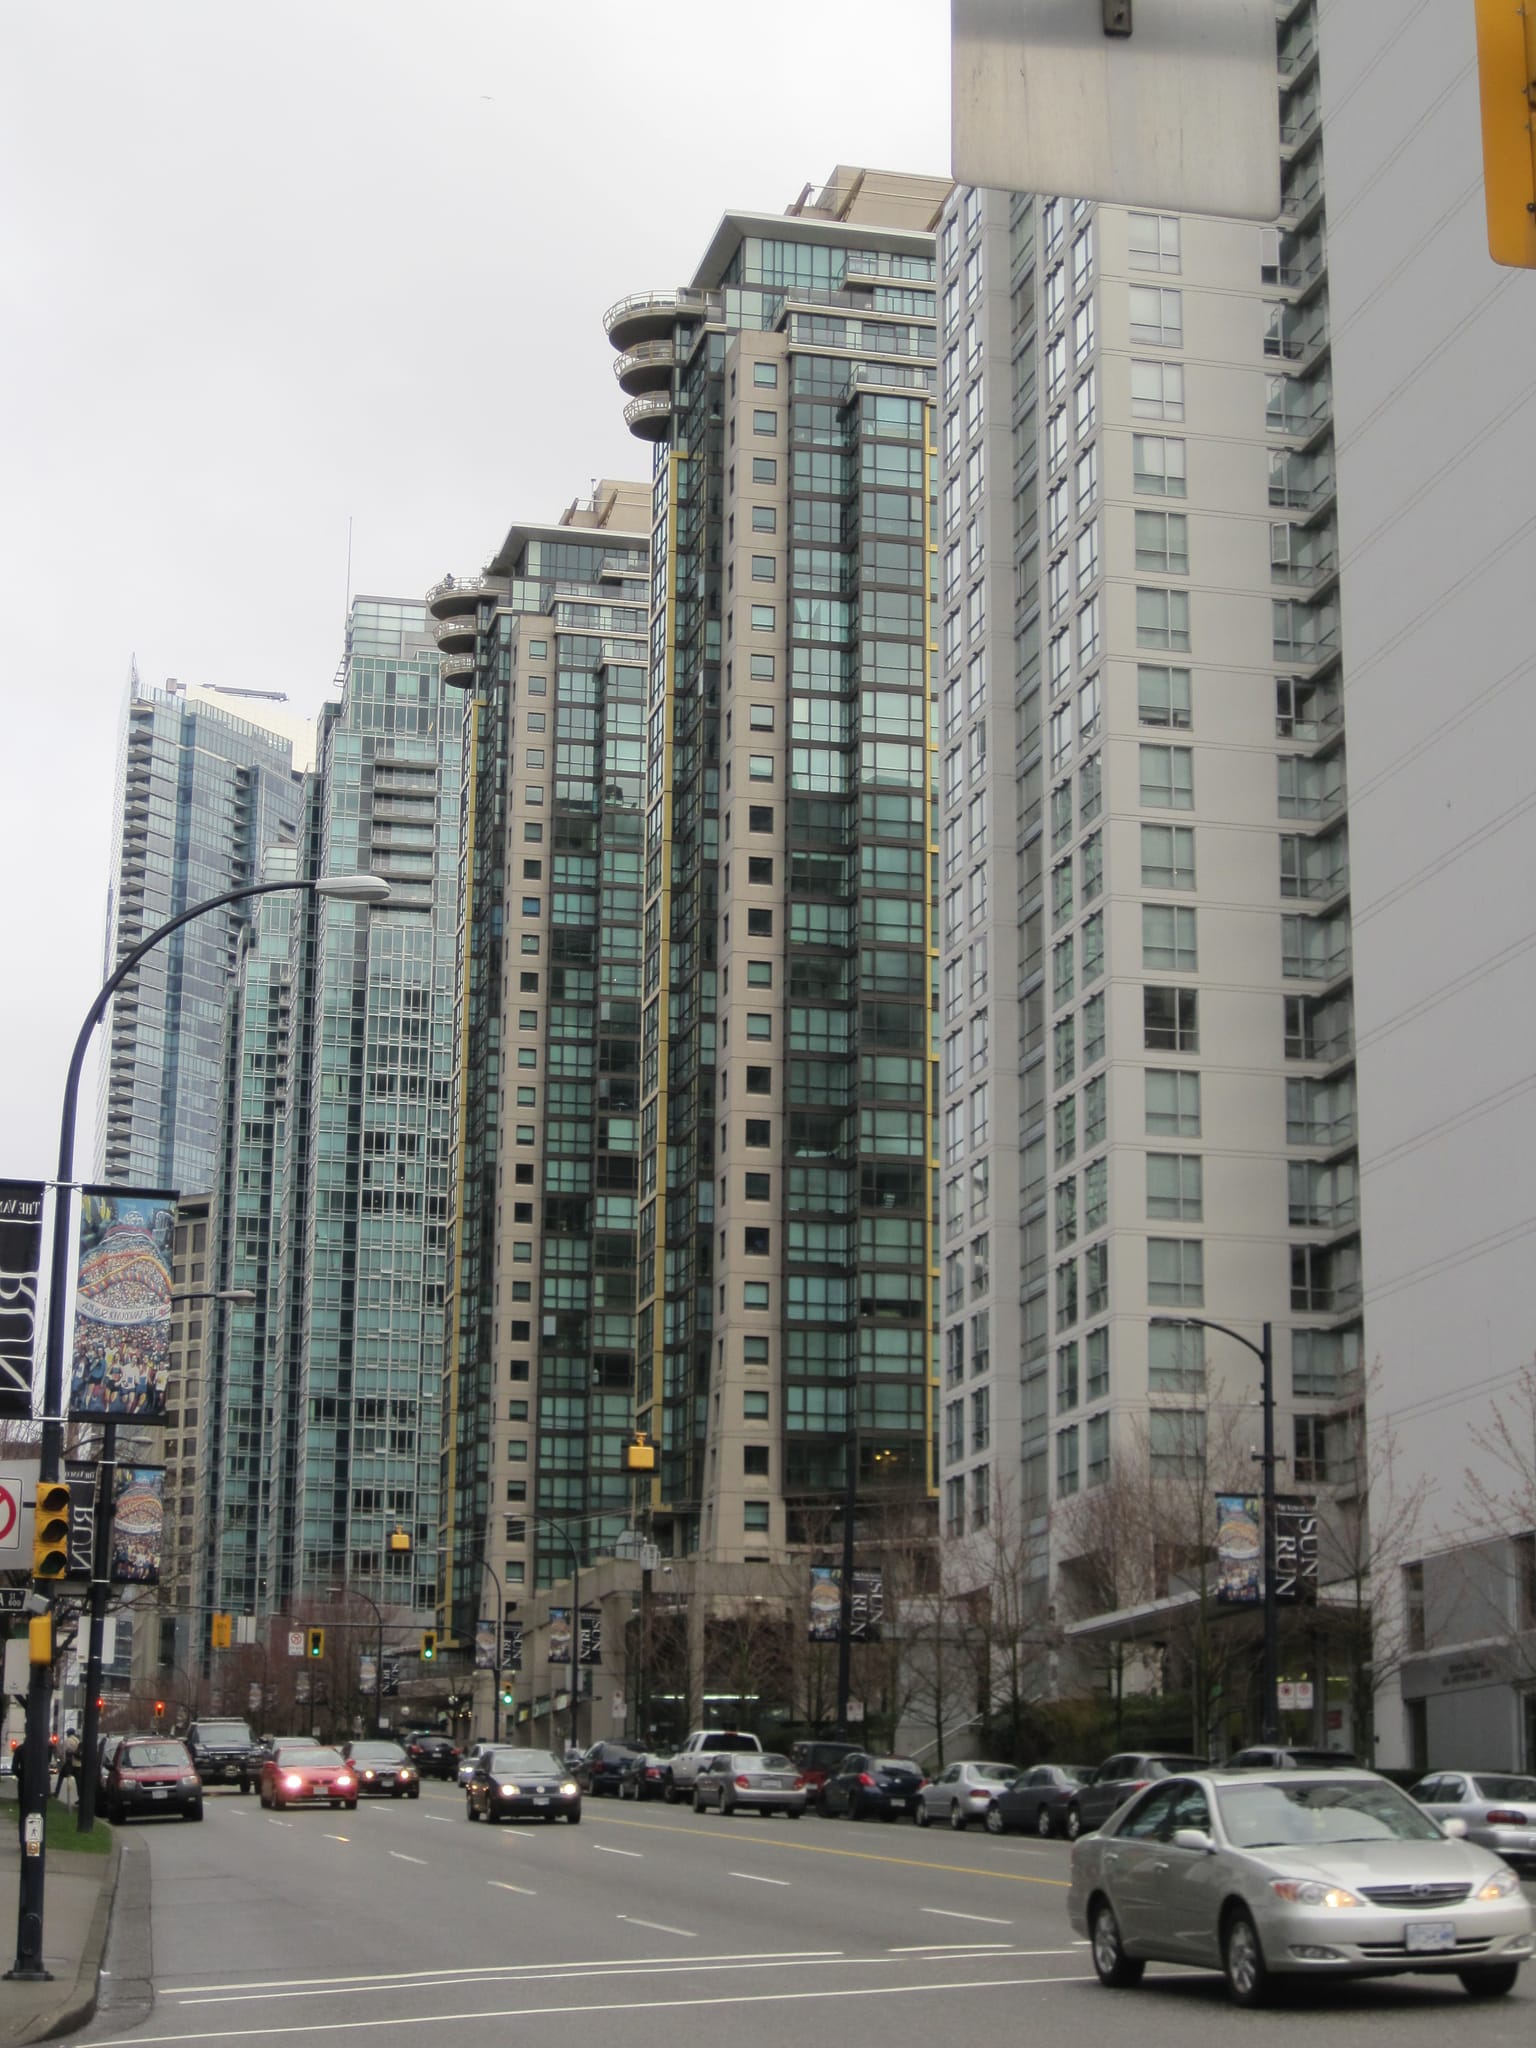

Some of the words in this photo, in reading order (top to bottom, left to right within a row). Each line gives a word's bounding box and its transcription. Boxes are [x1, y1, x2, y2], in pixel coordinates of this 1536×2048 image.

[1275, 1535, 1297, 1596] RUN
[1299, 1518, 1318, 1577] SUN
[851, 1594, 867, 1637] RUN
[869, 1582, 883, 1624] SUN
[580, 1629, 591, 1660] RUN
[591, 1620, 601, 1651] SUN
